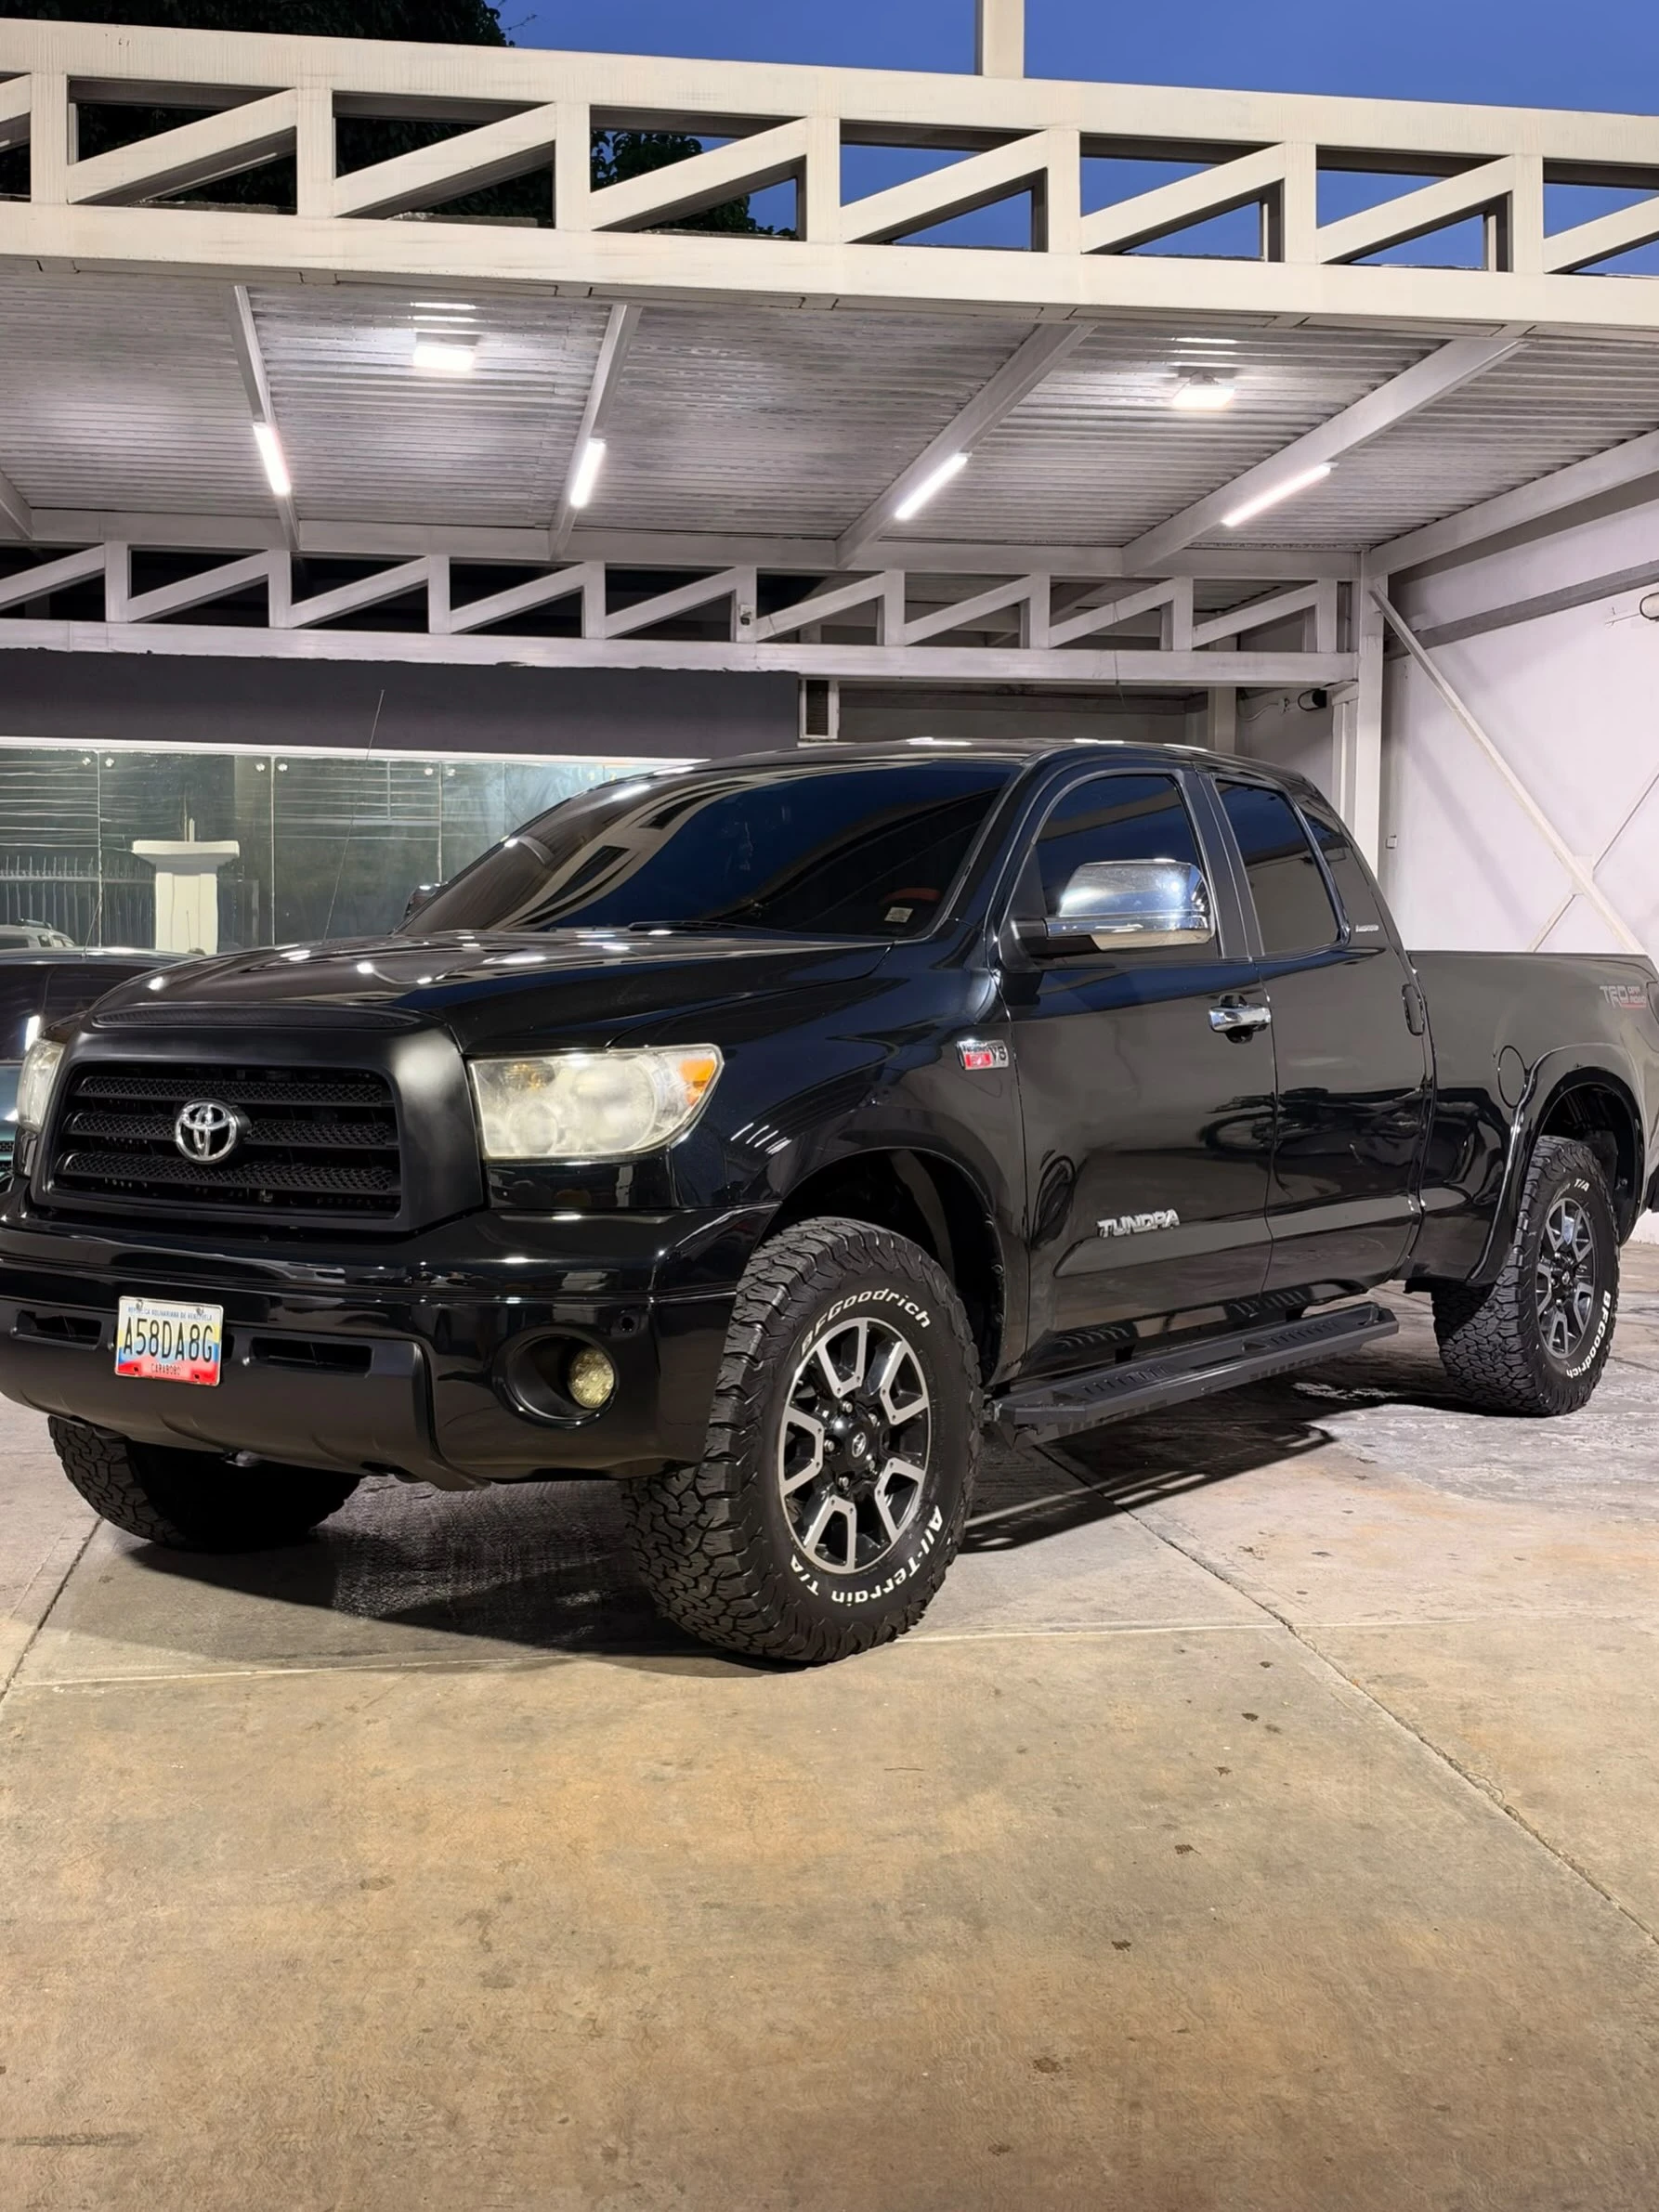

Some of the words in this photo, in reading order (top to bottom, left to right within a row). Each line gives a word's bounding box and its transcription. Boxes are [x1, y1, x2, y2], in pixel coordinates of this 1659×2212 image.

[1600, 985, 1628, 1009] TRD
[988, 1046, 1007, 1061] V8
[1574, 1178, 1590, 1192] T/A
[1096, 1208, 1181, 1238] TUNDRA
[124, 1317, 213, 1362] A58DA8G
[802, 1288, 931, 1356] BFGoodrich
[1566, 1290, 1612, 1379] BFGoodrich
[150, 1363, 181, 1376] CARABOBO
[831, 1504, 943, 1607] All-Terrain
[790, 1555, 818, 1596] T/A
